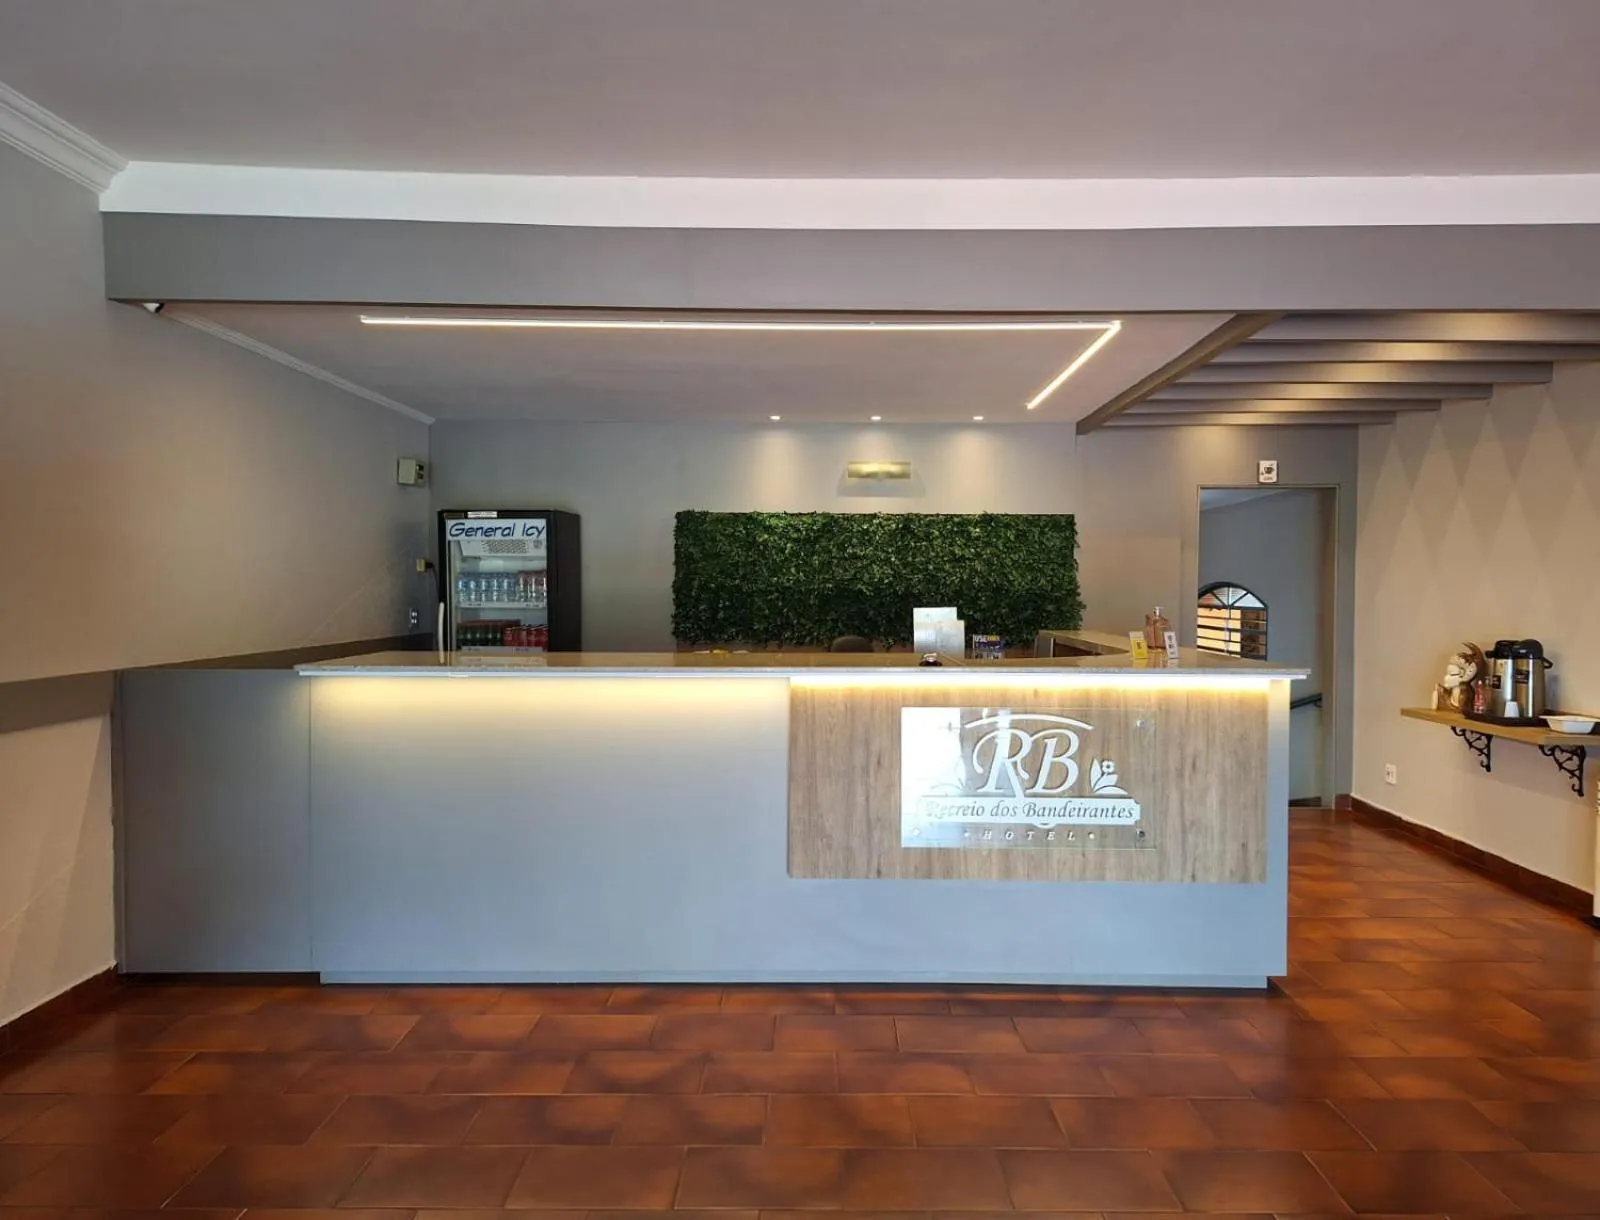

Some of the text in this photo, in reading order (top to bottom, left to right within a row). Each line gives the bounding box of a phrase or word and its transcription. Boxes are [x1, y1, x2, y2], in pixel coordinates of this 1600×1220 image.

[449, 522, 546, 538] General Icy
[972, 727, 1080, 799] RB
[990, 800, 1018, 818] dos
[1022, 800, 1135, 819] Bandeirantes
[982, 830, 1076, 841] HOTEL
